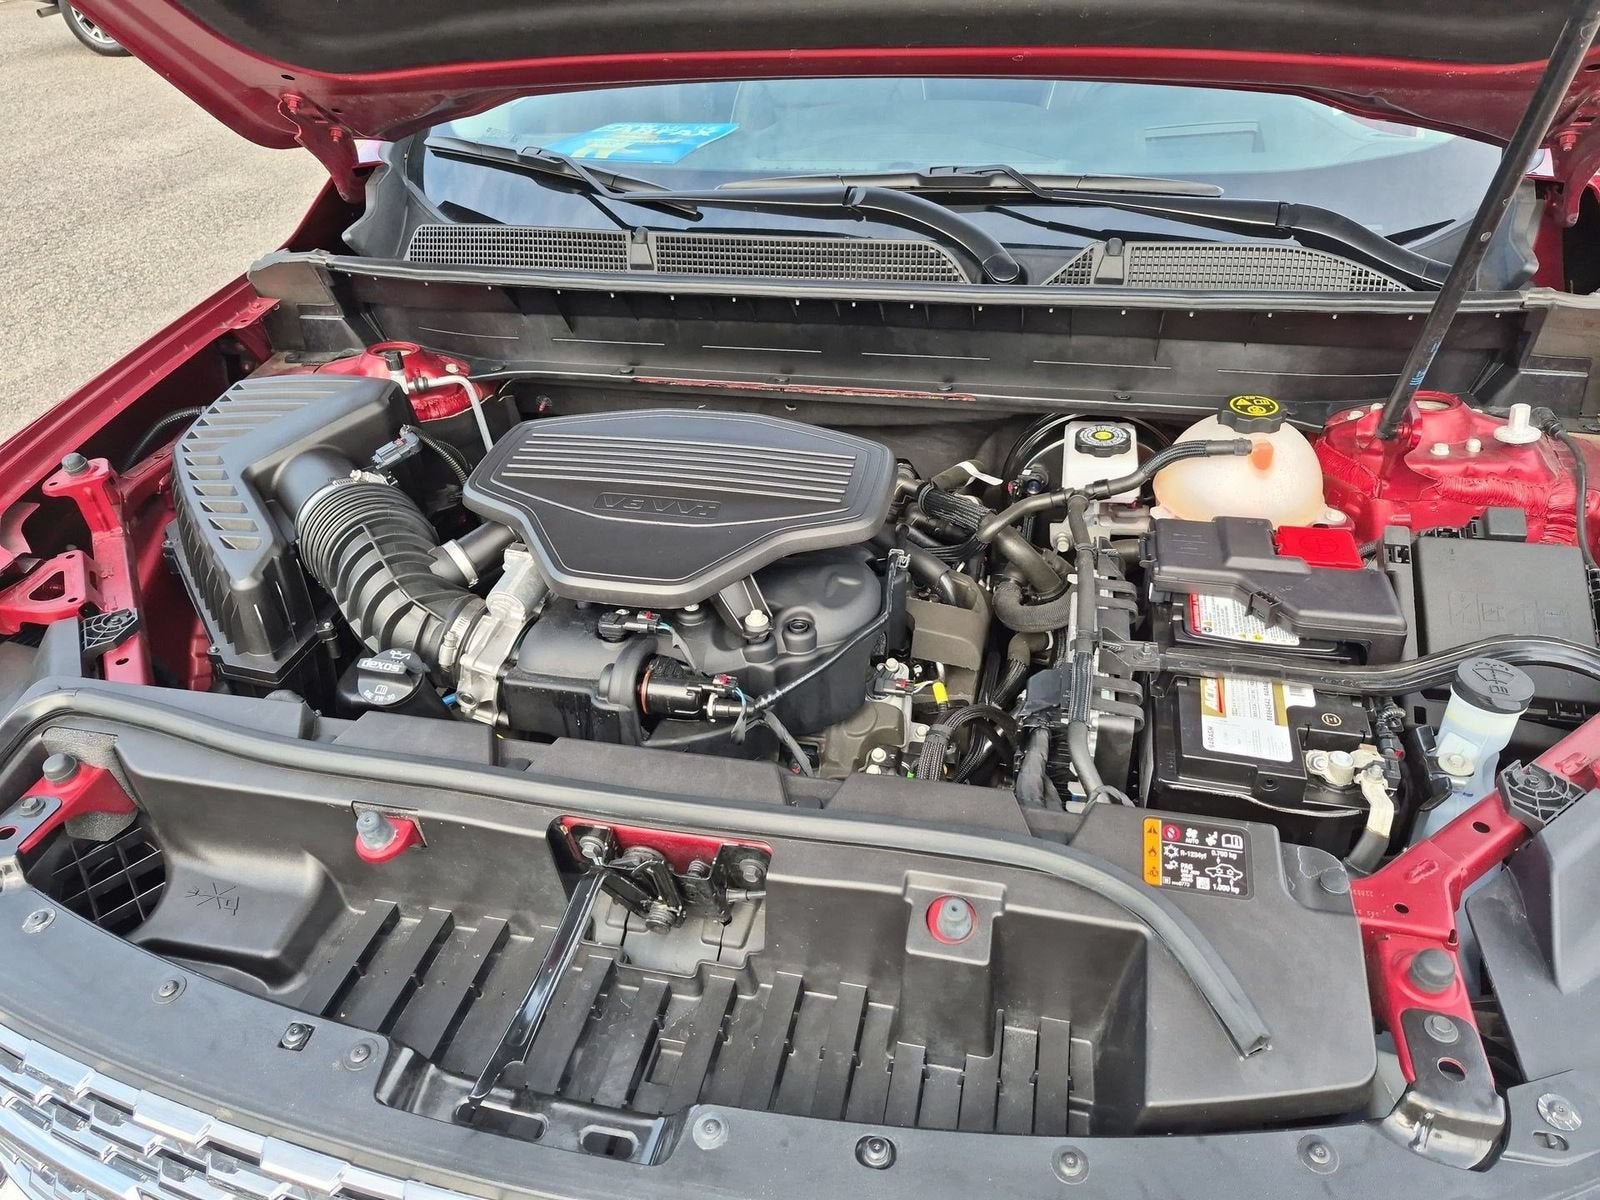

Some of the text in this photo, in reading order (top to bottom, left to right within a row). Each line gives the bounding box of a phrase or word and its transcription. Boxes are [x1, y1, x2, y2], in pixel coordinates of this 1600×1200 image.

[602, 496, 718, 516] V6 VVT
[361, 659, 399, 672] dexos
[1180, 849, 1208, 860] R-1234yf
[1229, 852, 1238, 860] kg
[1230, 885, 1240, 895] kg
